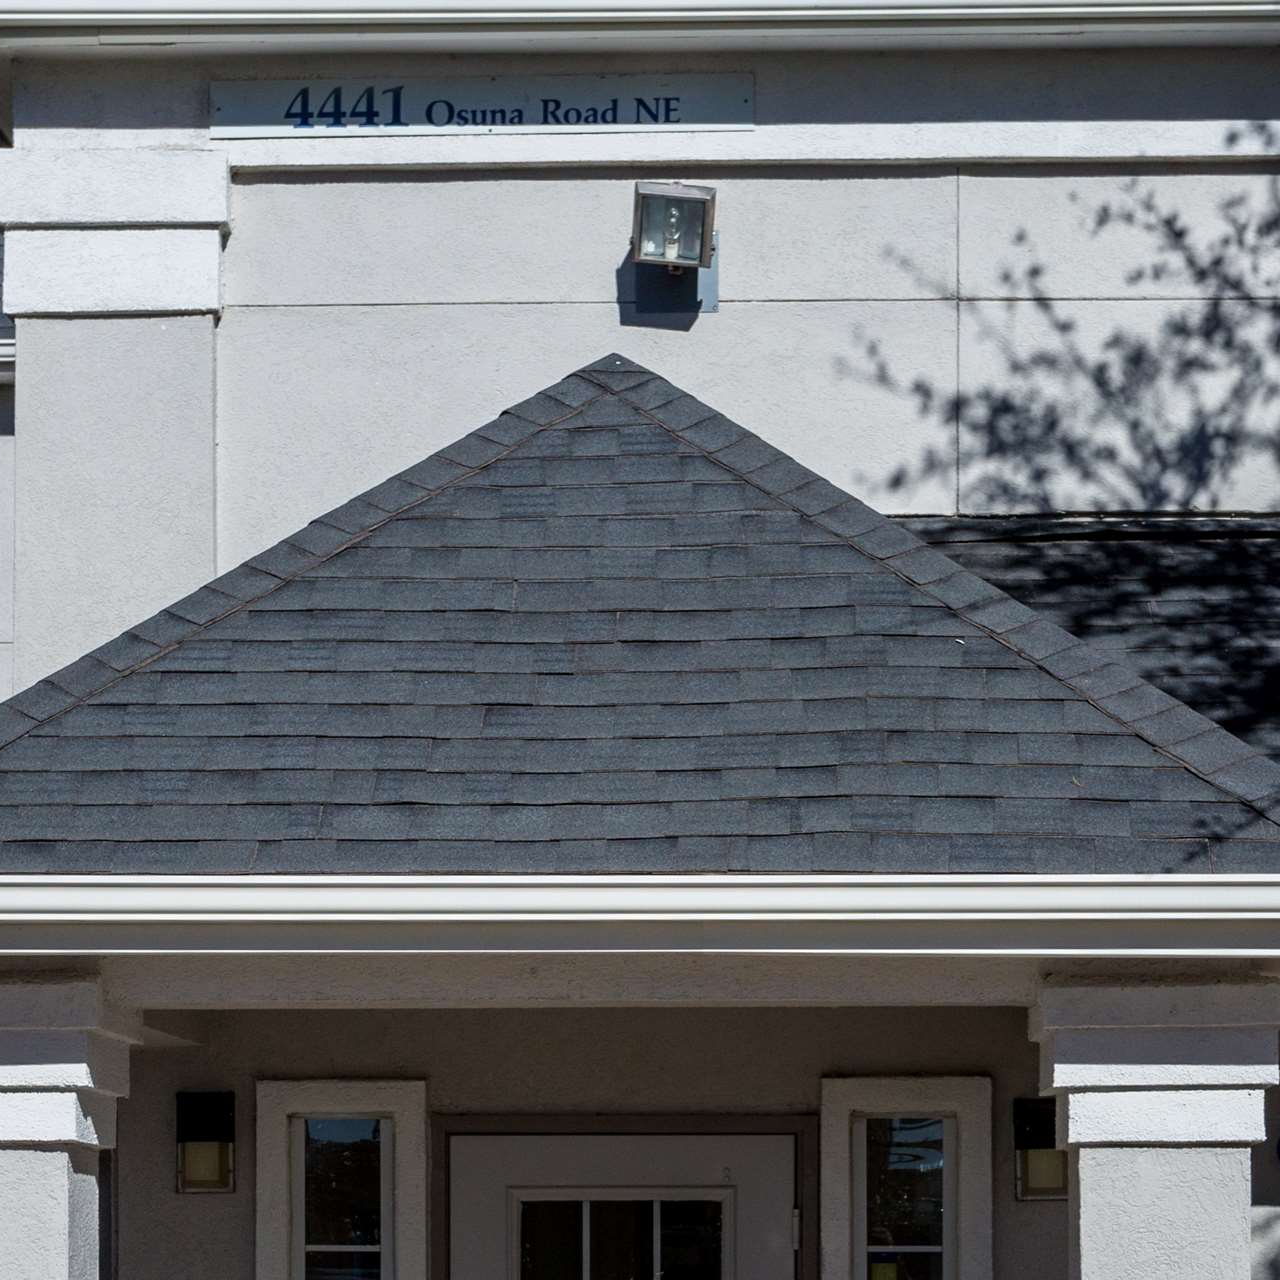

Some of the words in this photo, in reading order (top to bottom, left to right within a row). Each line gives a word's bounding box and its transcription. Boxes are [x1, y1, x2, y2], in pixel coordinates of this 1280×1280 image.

[283, 85, 409, 128] 4441
[426, 99, 524, 127] Osuna
[542, 98, 618, 126] Road
[635, 97, 681, 124] NE
